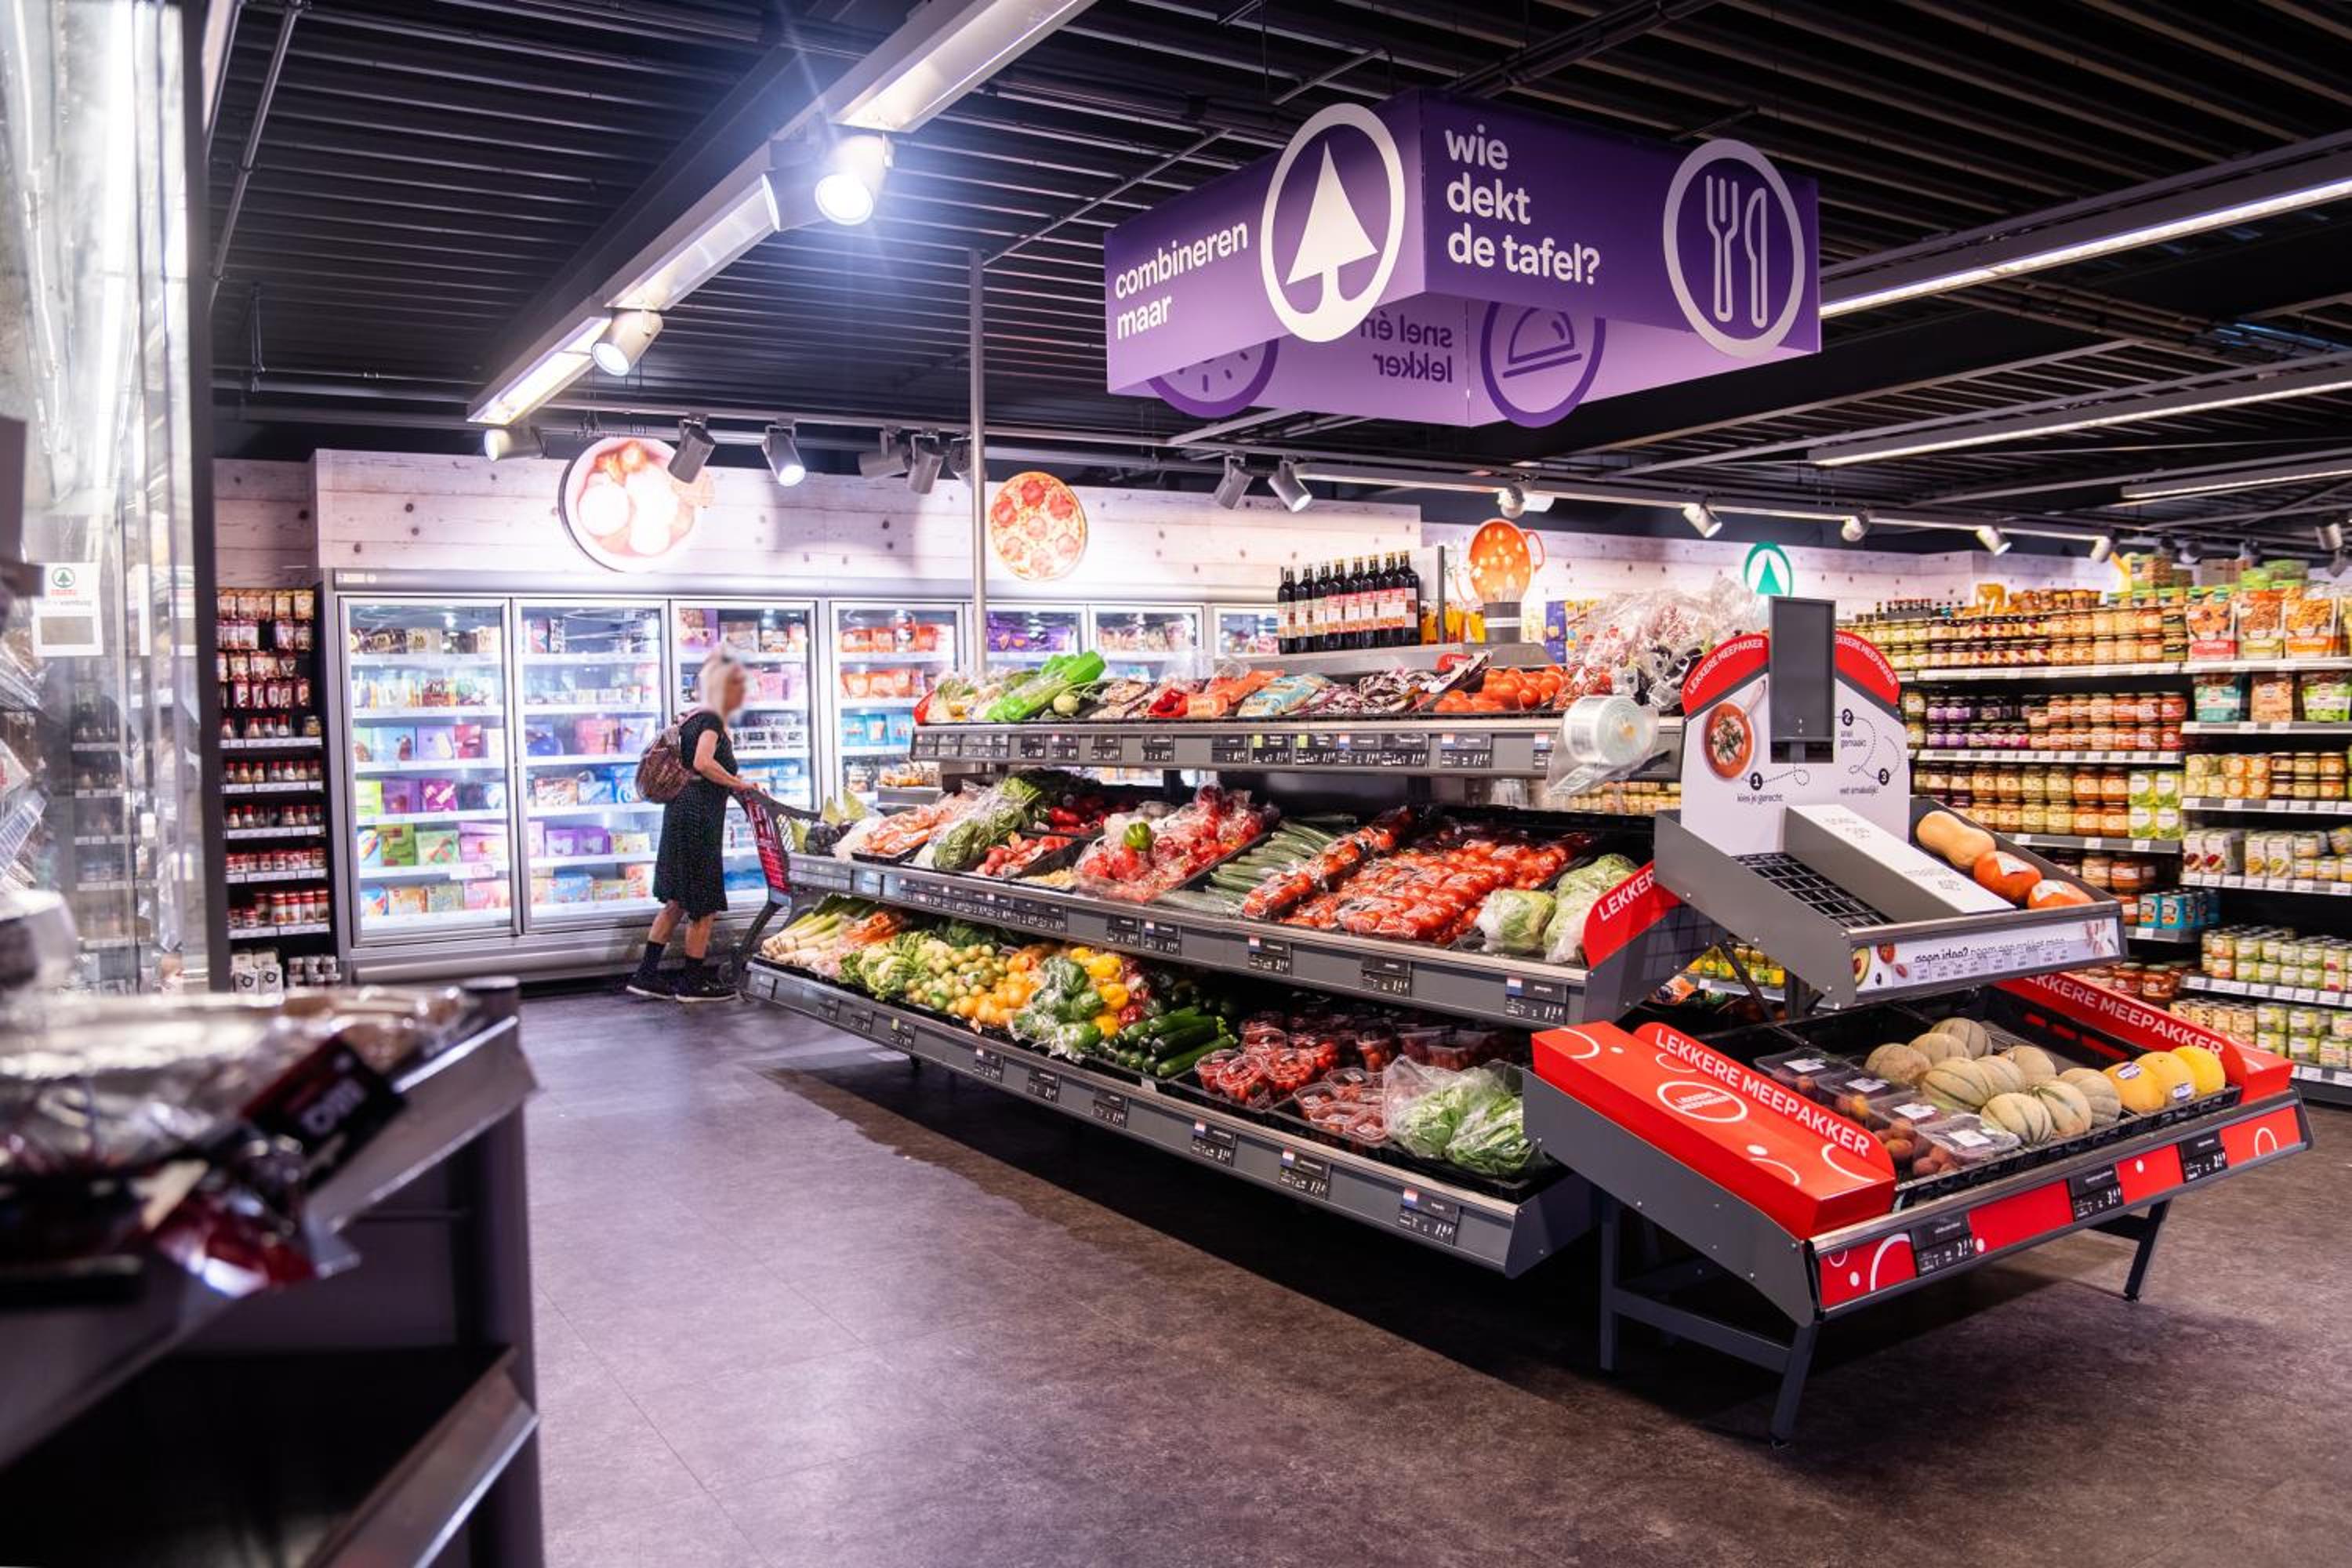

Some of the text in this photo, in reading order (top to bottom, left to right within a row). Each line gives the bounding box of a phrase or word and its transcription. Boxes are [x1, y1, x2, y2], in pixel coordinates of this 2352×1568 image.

[1445, 124, 1509, 170] wie
[1446, 172, 1531, 225] dekt
[1115, 223, 1248, 299] combineren
[1448, 222, 1600, 285] de tafel?
[1117, 296, 1172, 339] maar
[1835, 634, 1862, 652] EKKERE
[1598, 869, 1655, 922] LEKKER
[2100, 997, 2224, 1054] MEEPAKKER
[1656, 1029, 1871, 1157] LEKKERE MEEPAKKER
